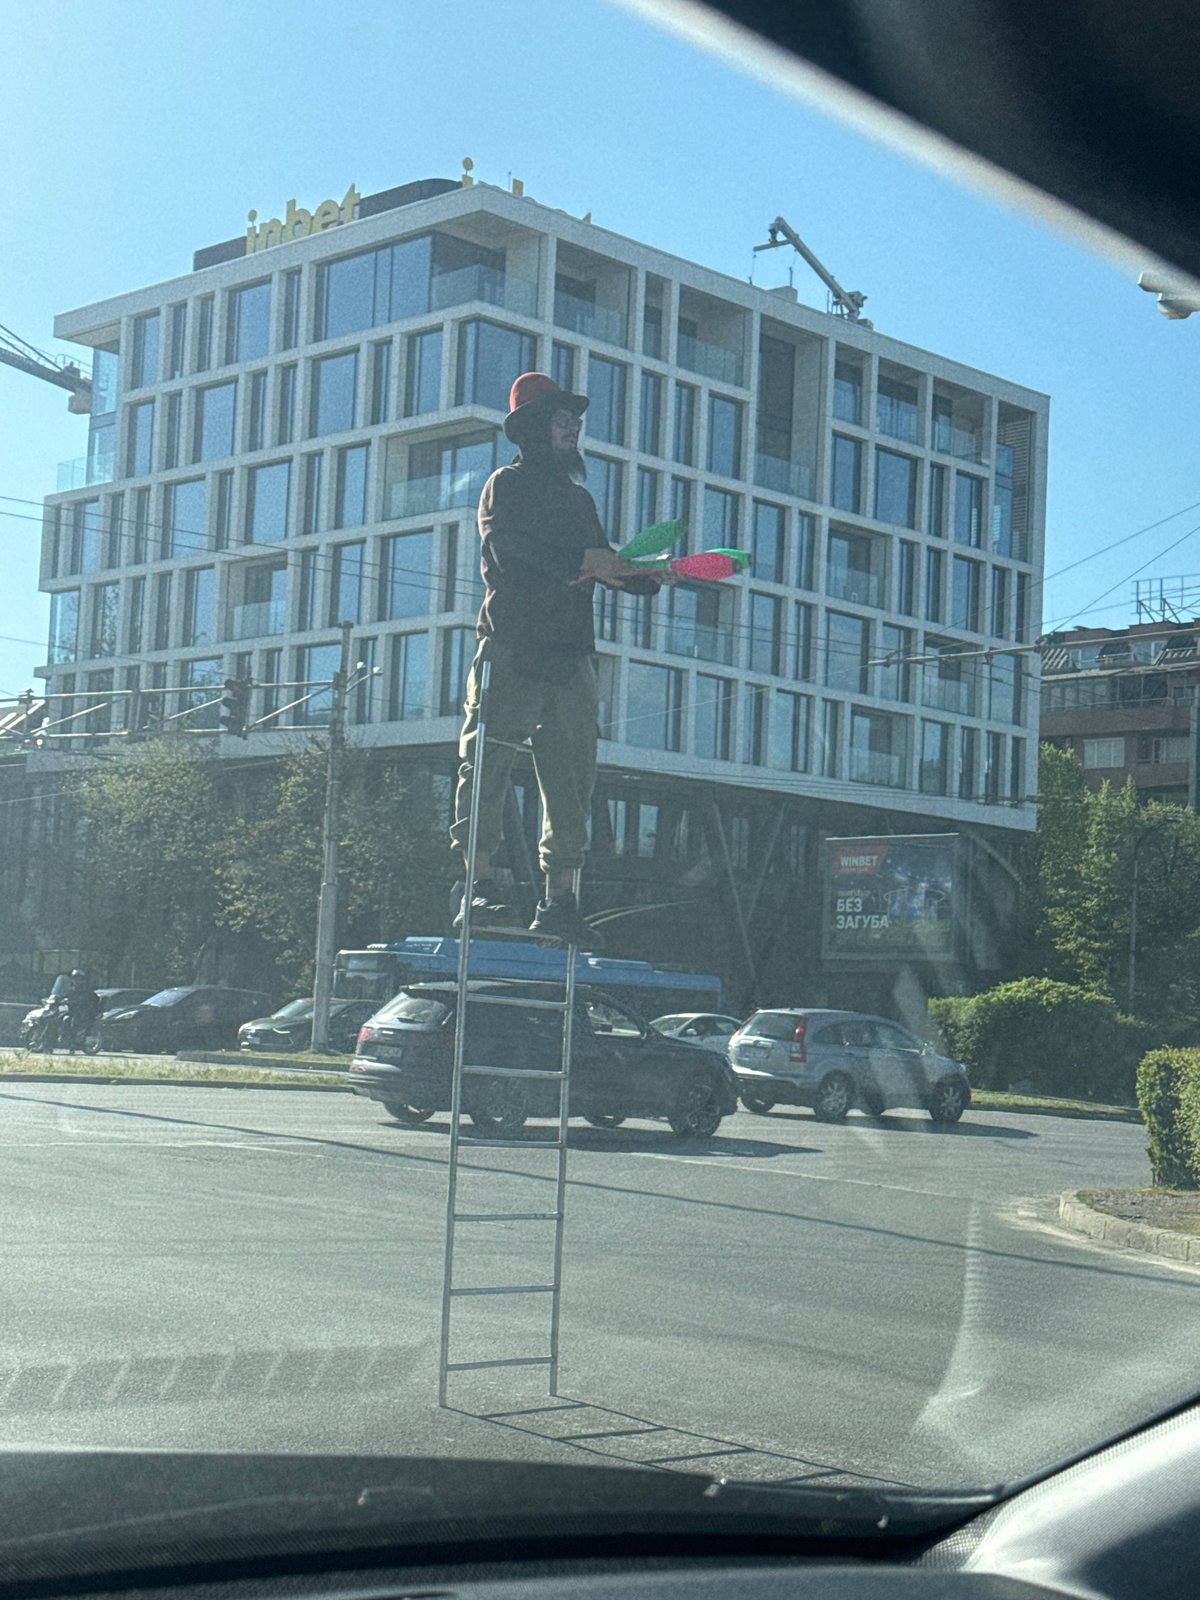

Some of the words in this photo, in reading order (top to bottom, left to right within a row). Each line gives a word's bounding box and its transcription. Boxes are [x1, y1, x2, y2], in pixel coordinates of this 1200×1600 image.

[840, 856, 878, 866] WINBET
[837, 898, 862, 912] БЕЗ
[836, 915, 889, 928] ЗАГУБА
